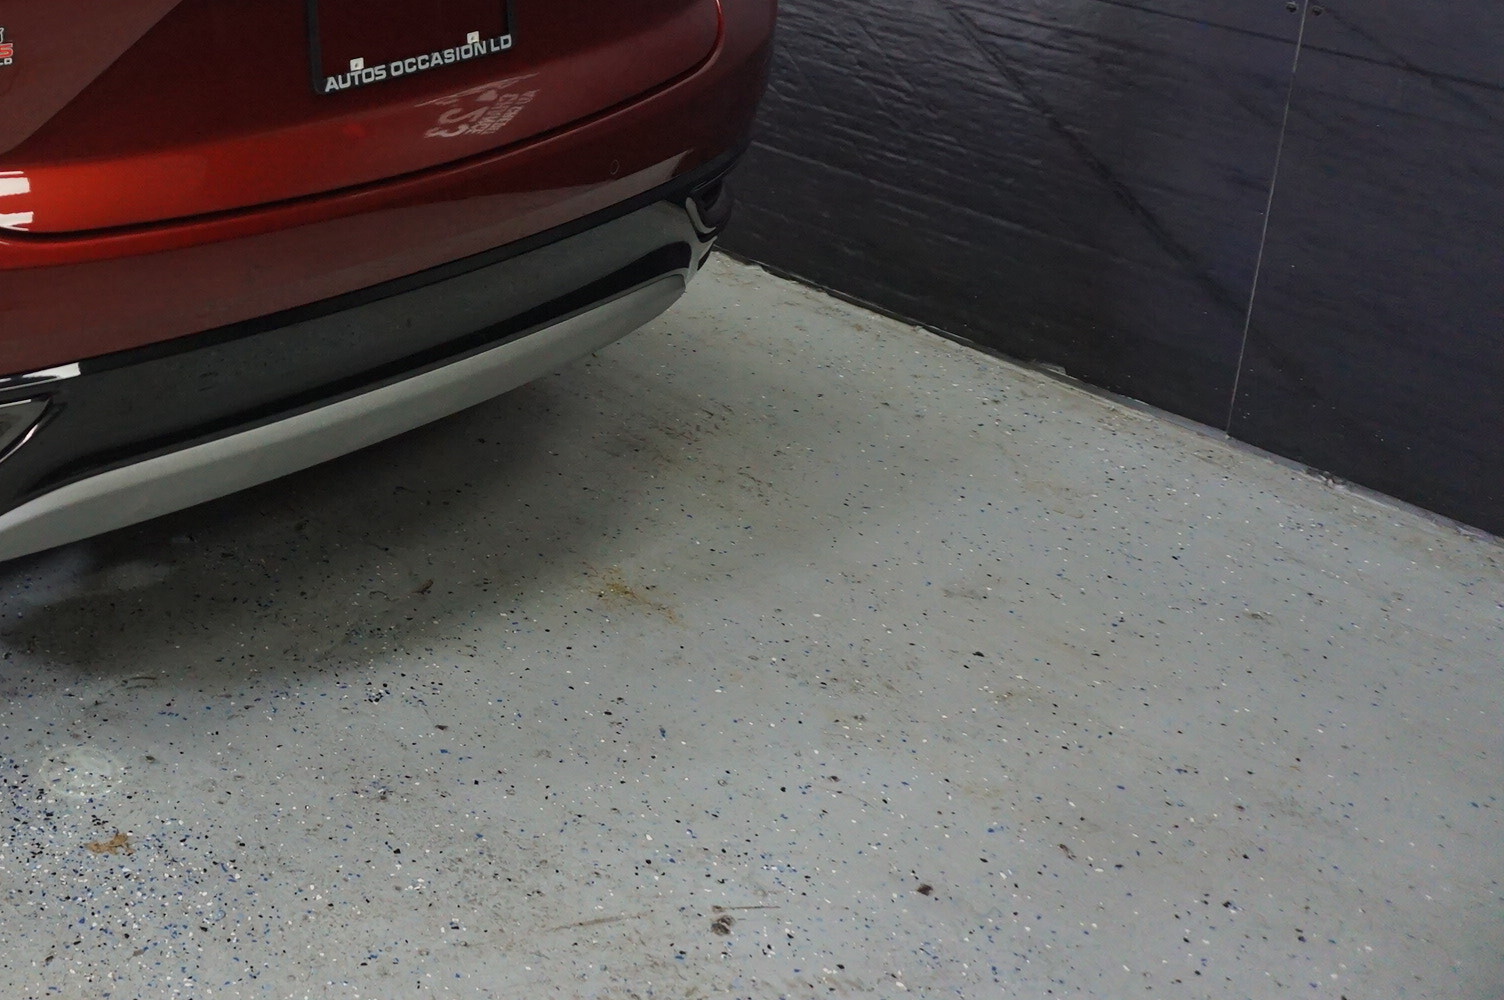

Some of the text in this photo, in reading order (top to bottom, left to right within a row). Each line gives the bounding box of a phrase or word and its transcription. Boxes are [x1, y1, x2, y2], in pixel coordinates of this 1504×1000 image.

[324, 34, 512, 92] AUTOS OCCASION LD
